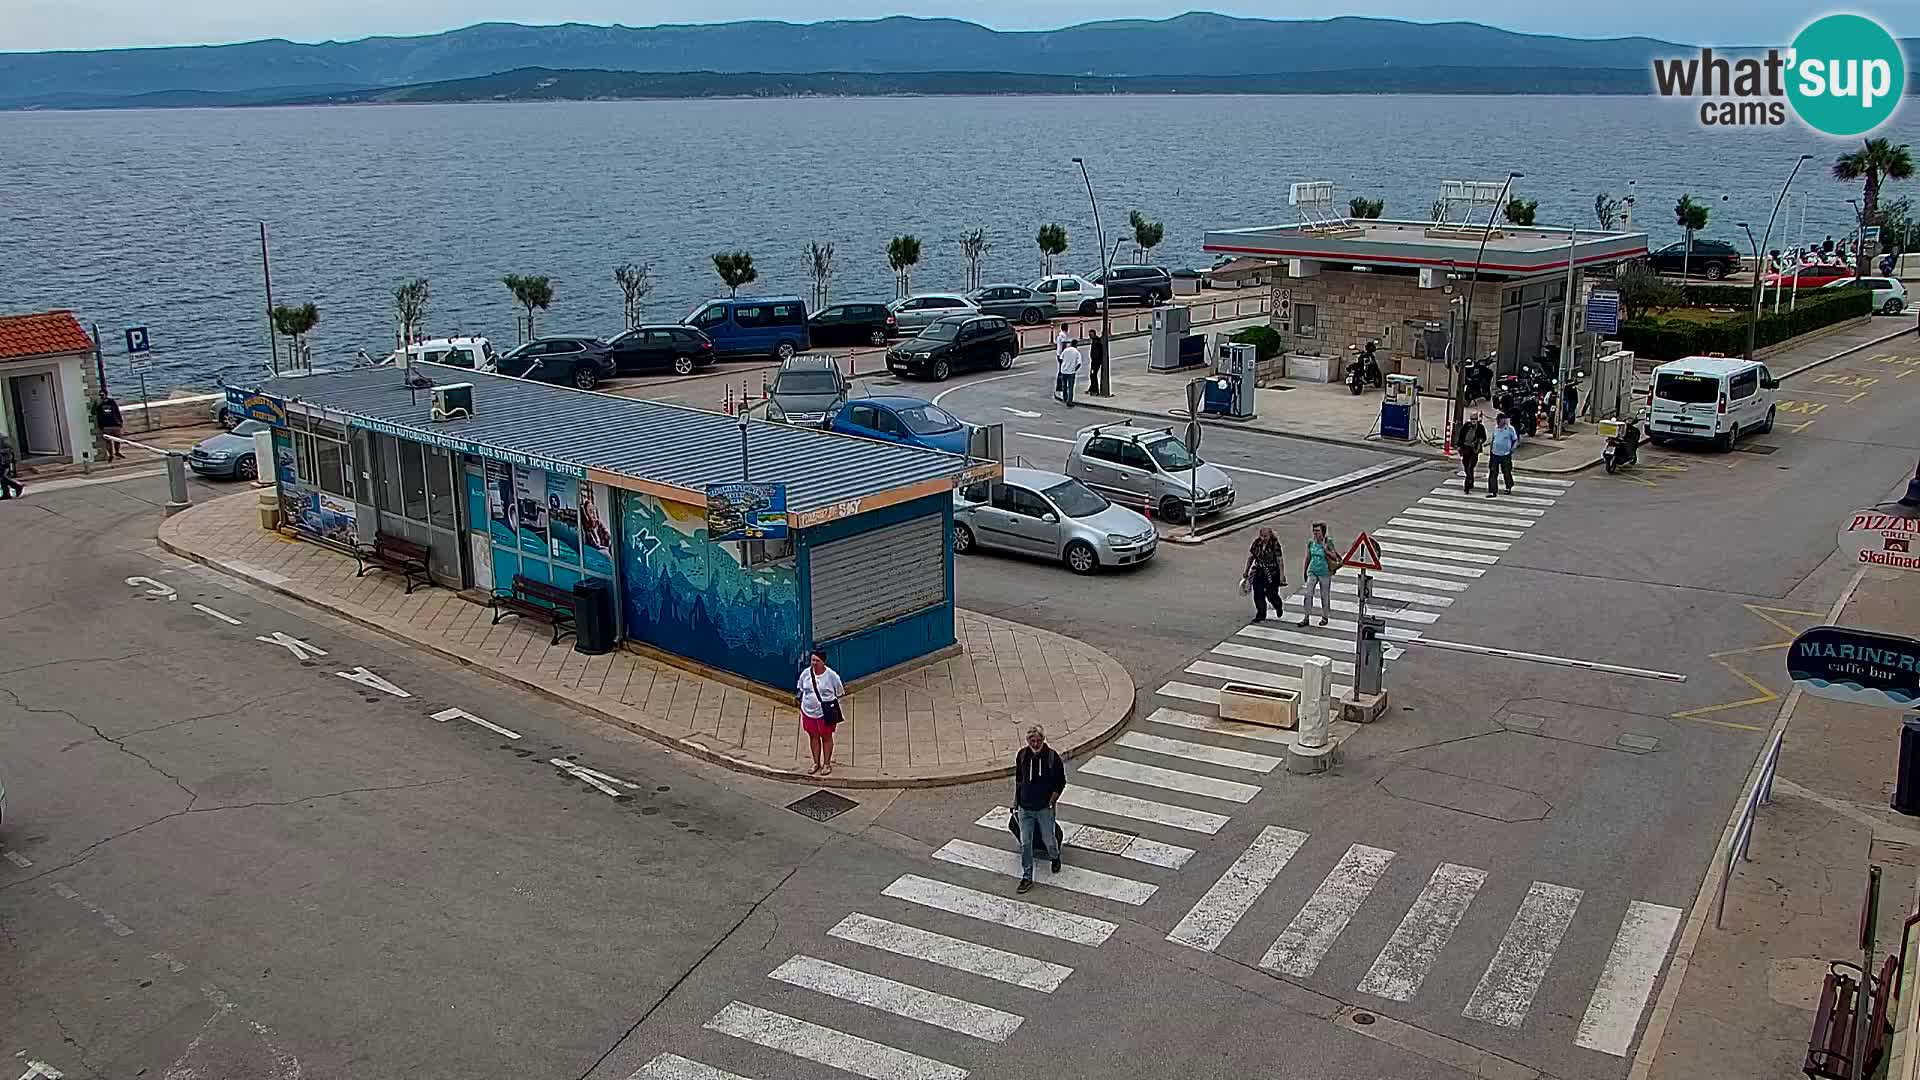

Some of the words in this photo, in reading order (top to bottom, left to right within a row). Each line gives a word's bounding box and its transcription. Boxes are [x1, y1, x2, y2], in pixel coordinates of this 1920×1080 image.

[131, 331, 143, 349] P
[1776, 399, 1829, 415] AXI
[396, 427, 436, 445] AUTOBUSNA
[437, 437, 469, 452] POSTAJA
[479, 445, 494, 457] BUS
[494, 448, 527, 465] STATION
[528, 456, 555, 471] TICKET
[555, 462, 583, 477] OFFICE
[1848, 515, 1920, 533] PIZZE
[1881, 530, 1917, 541] GRILL
[1828, 662, 1865, 674] caffe
[1869, 665, 1897, 681] bar
